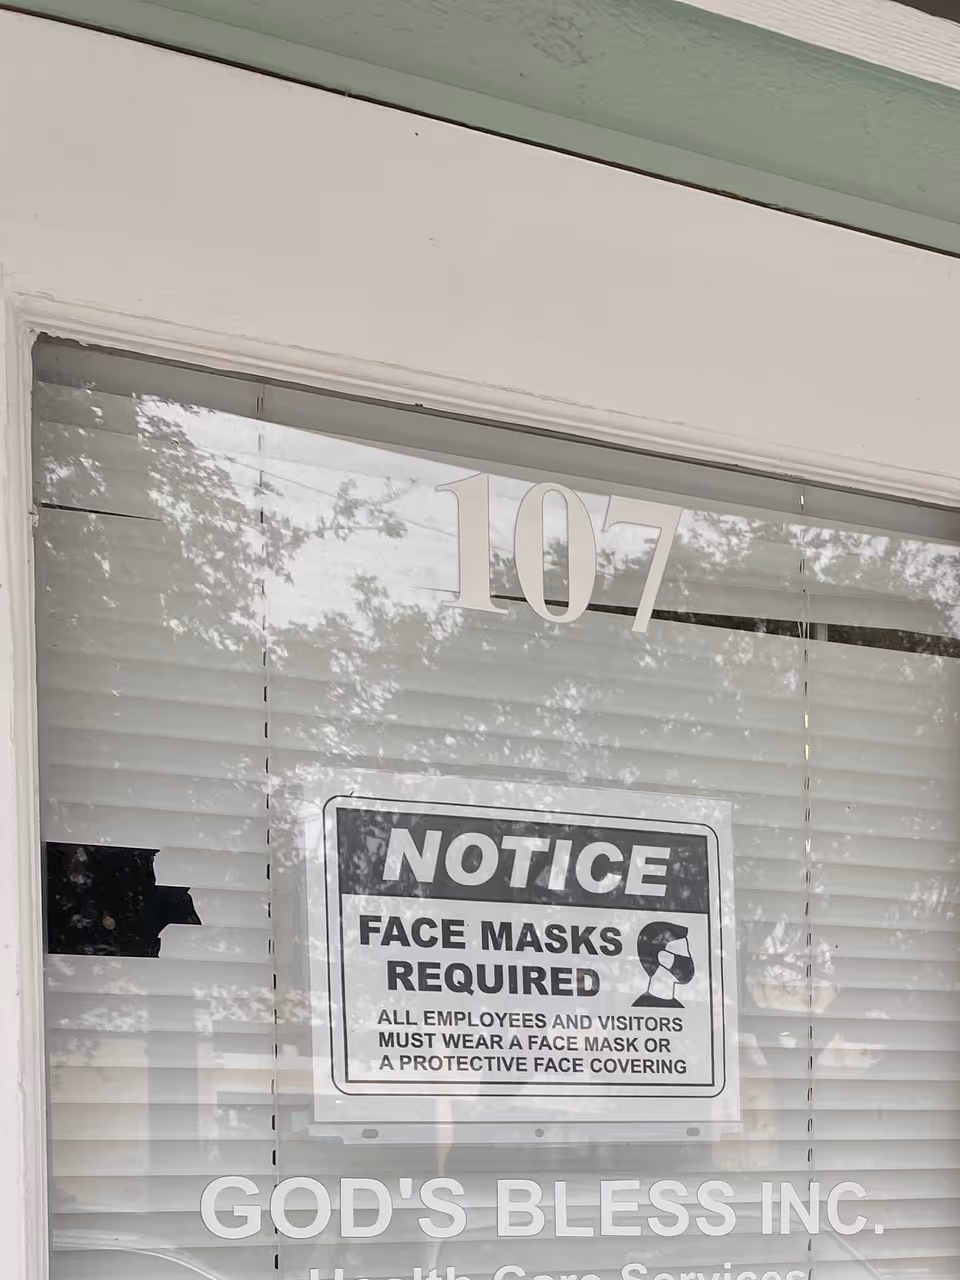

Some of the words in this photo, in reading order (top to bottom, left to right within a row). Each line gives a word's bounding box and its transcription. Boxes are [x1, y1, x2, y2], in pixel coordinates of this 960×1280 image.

[435, 472, 683, 633] 107
[382, 828, 671, 897] NOTICE
[359, 915, 466, 950] FACE
[481, 920, 623, 956] MASKS
[387, 961, 600, 997] REQUIRED
[377, 1009, 417, 1027] ALL
[423, 1011, 547, 1029] EMPLOYEES
[551, 1014, 593, 1030] AND
[598, 1016, 683, 1032] VISITORS
[378, 1032, 437, 1049] MUST
[441, 1033, 505, 1050] WEAR
[508, 1035, 523, 1050] A
[528, 1035, 579, 1052] FACE
[584, 1036, 639, 1052] MASK
[643, 1038, 671, 1053] OR
[379, 1054, 394, 1071] A
[399, 1055, 527, 1072] PROTECTIVE
[533, 1057, 584, 1073] FACE
[589, 1058, 687, 1075] COVERING
[200, 1175, 467, 1239] GOD'S
[497, 1178, 736, 1237] BLESS
[761, 1179, 885, 1236] INC.
